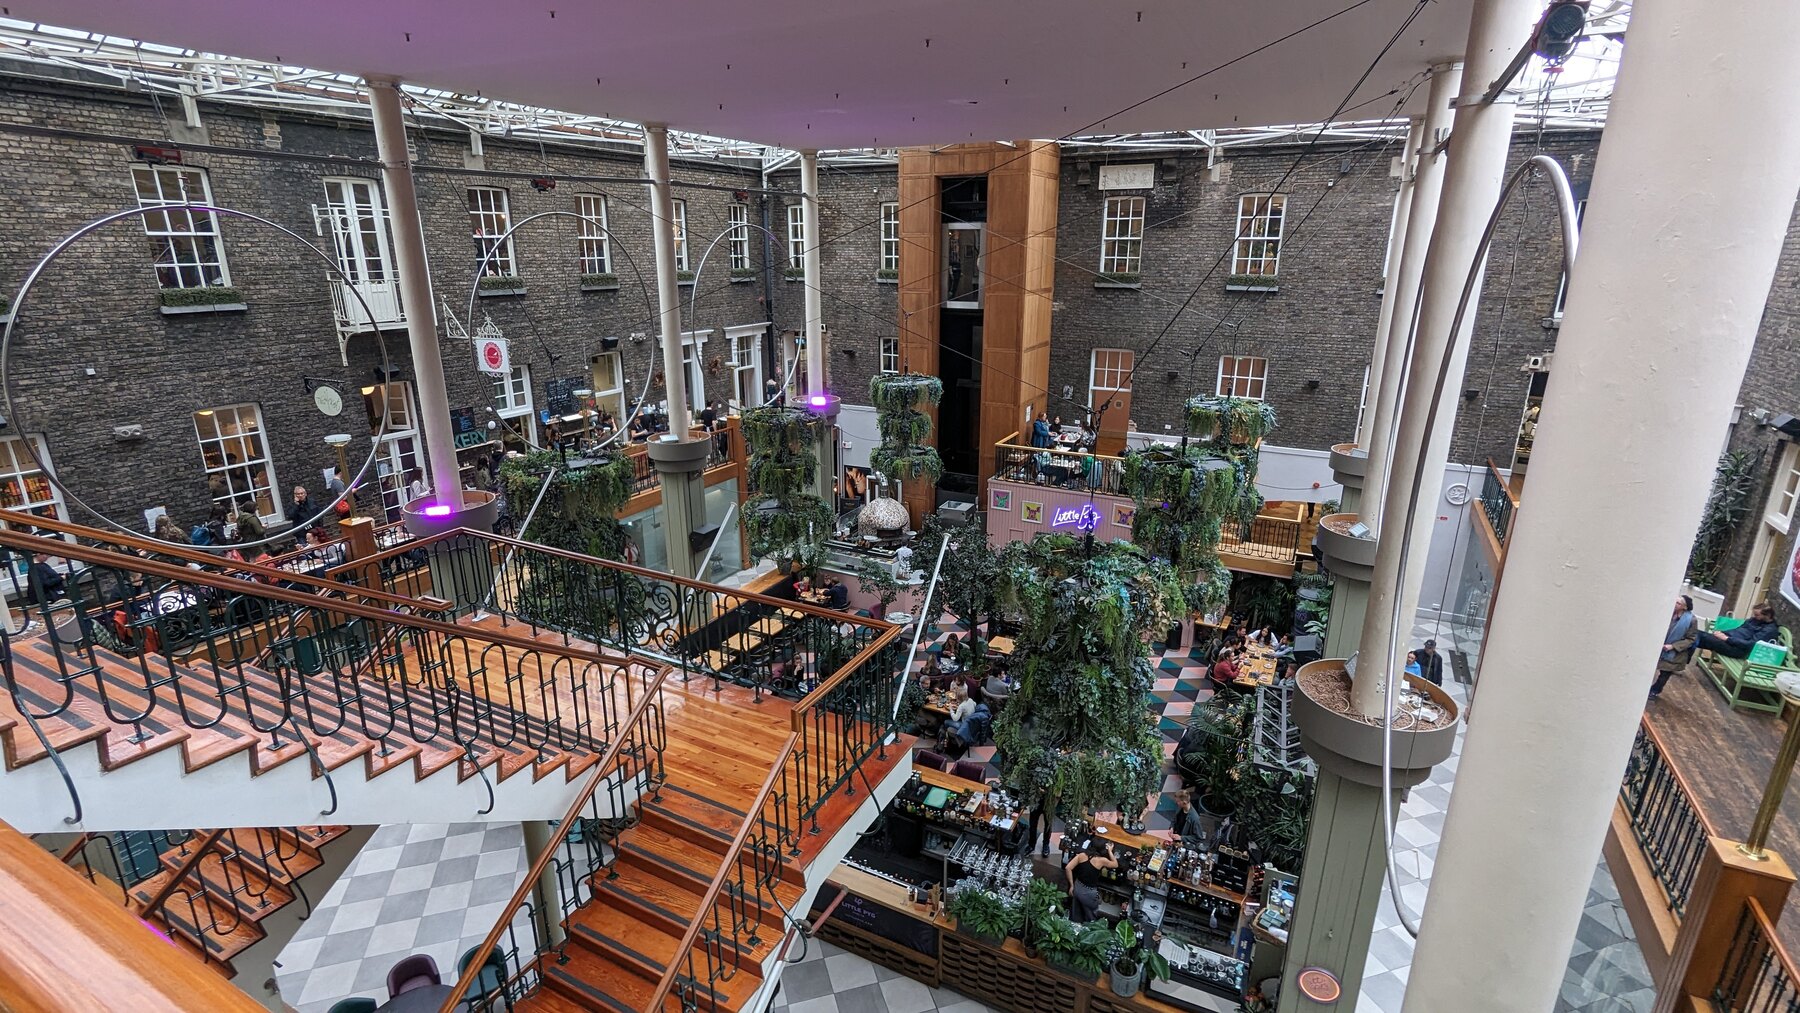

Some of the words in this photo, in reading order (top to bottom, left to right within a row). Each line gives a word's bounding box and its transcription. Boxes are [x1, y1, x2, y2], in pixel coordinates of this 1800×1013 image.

[454, 429, 487, 449] KERY
[841, 901, 862, 913] LITTLE
[863, 909, 876, 919] PYG
